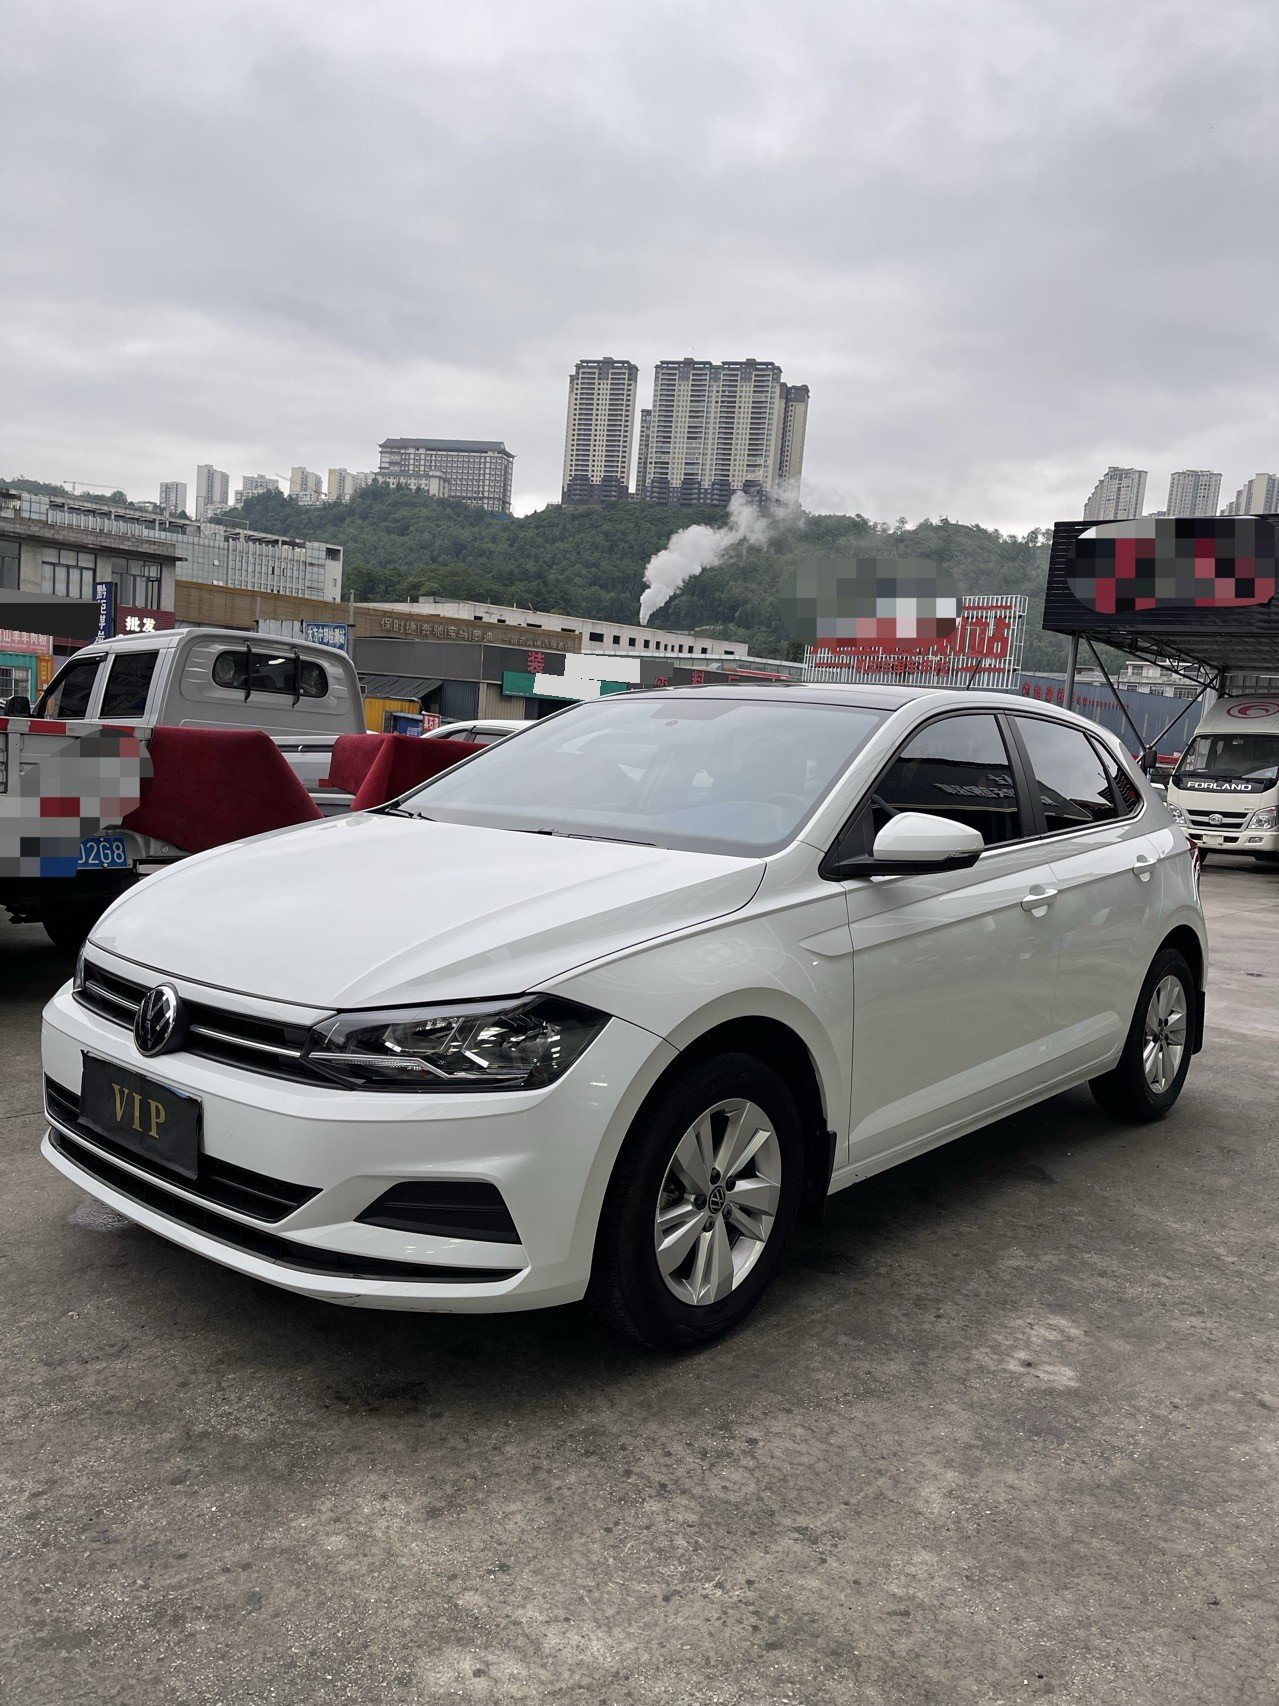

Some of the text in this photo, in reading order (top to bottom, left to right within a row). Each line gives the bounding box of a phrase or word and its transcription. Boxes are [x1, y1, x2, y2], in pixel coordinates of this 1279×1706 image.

[125, 615, 156, 632] 批发
[1187, 781, 1252, 791] FORLAND
[112, 1083, 166, 1139] VIP
